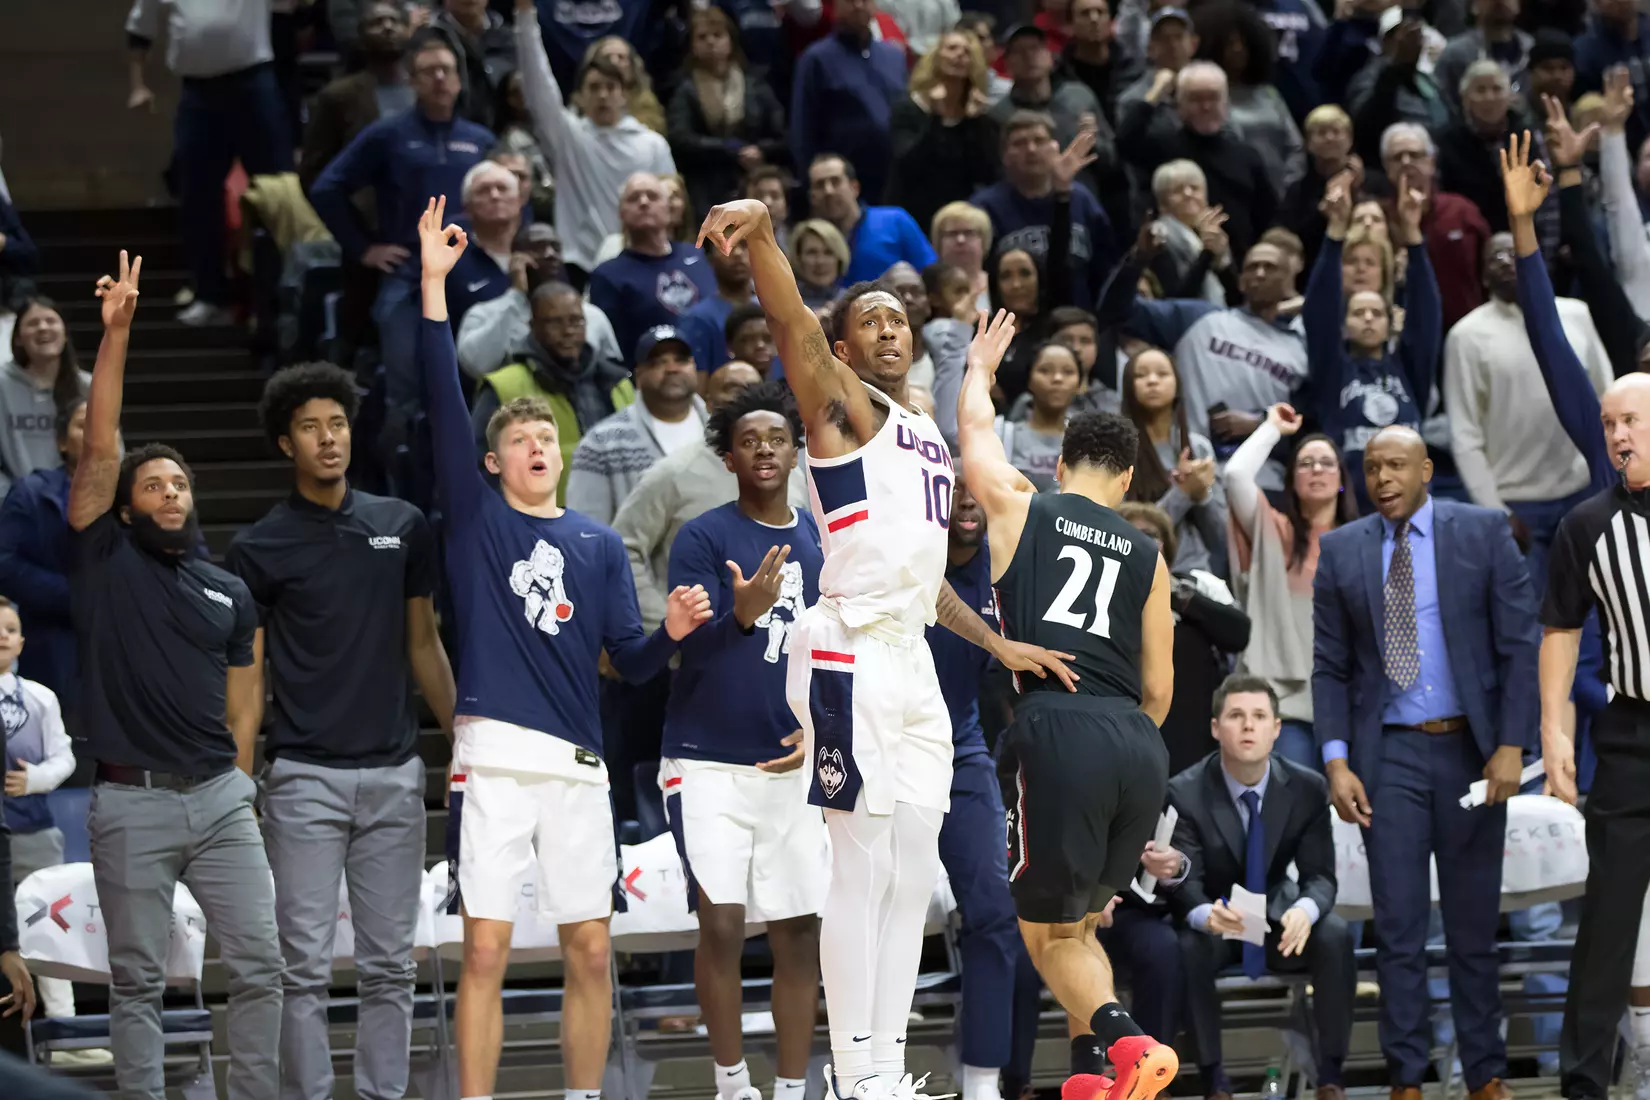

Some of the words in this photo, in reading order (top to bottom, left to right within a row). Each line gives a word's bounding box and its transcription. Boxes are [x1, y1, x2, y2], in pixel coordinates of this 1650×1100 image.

[8, 413, 53, 431] UCO
[896, 423, 955, 472] UCON
[921, 466, 951, 529] 10
[1055, 516, 1132, 556] CUMBERLAND
[1041, 544, 1121, 639] 21
[1507, 822, 1577, 843] CKET
